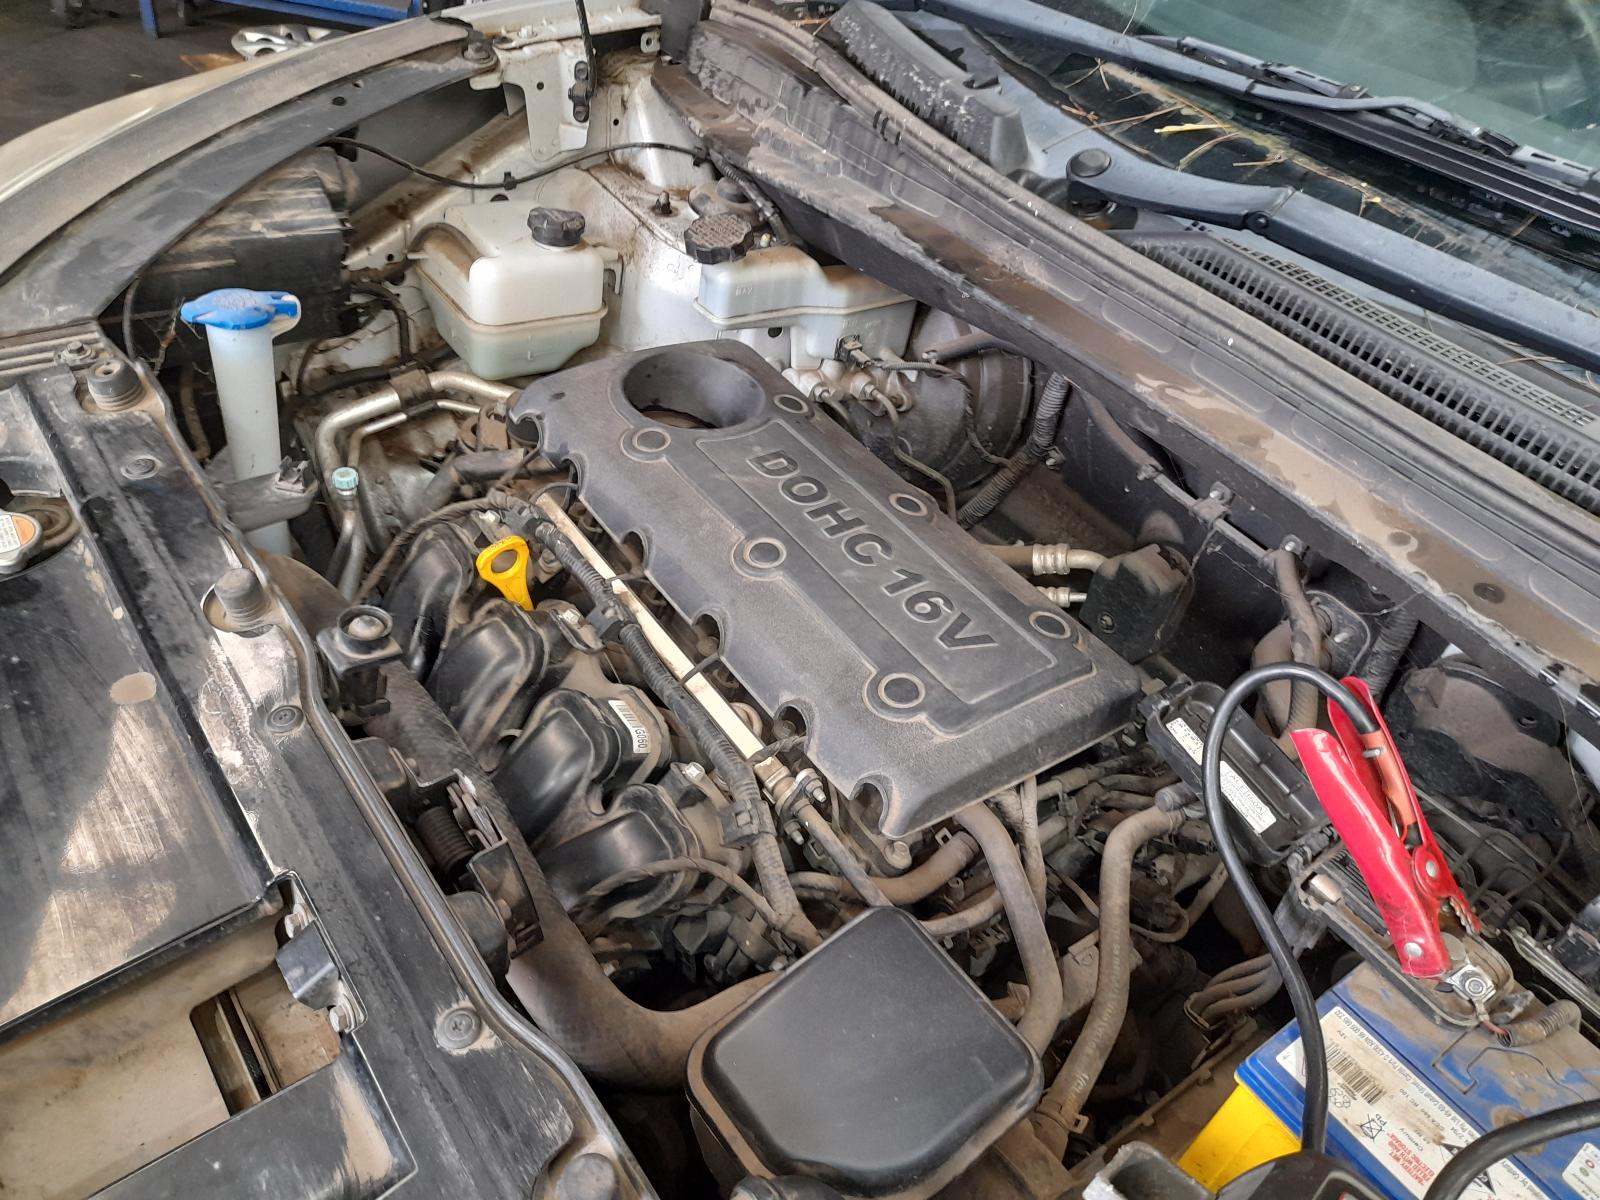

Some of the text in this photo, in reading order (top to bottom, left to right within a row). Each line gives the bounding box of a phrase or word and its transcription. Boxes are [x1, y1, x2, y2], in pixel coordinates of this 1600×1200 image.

[746, 451, 999, 649] DOHC 16V
[1373, 1112, 1387, 1126] Pb
[1398, 1127, 1423, 1151] Century
[1449, 1125, 1464, 1139] 2794
